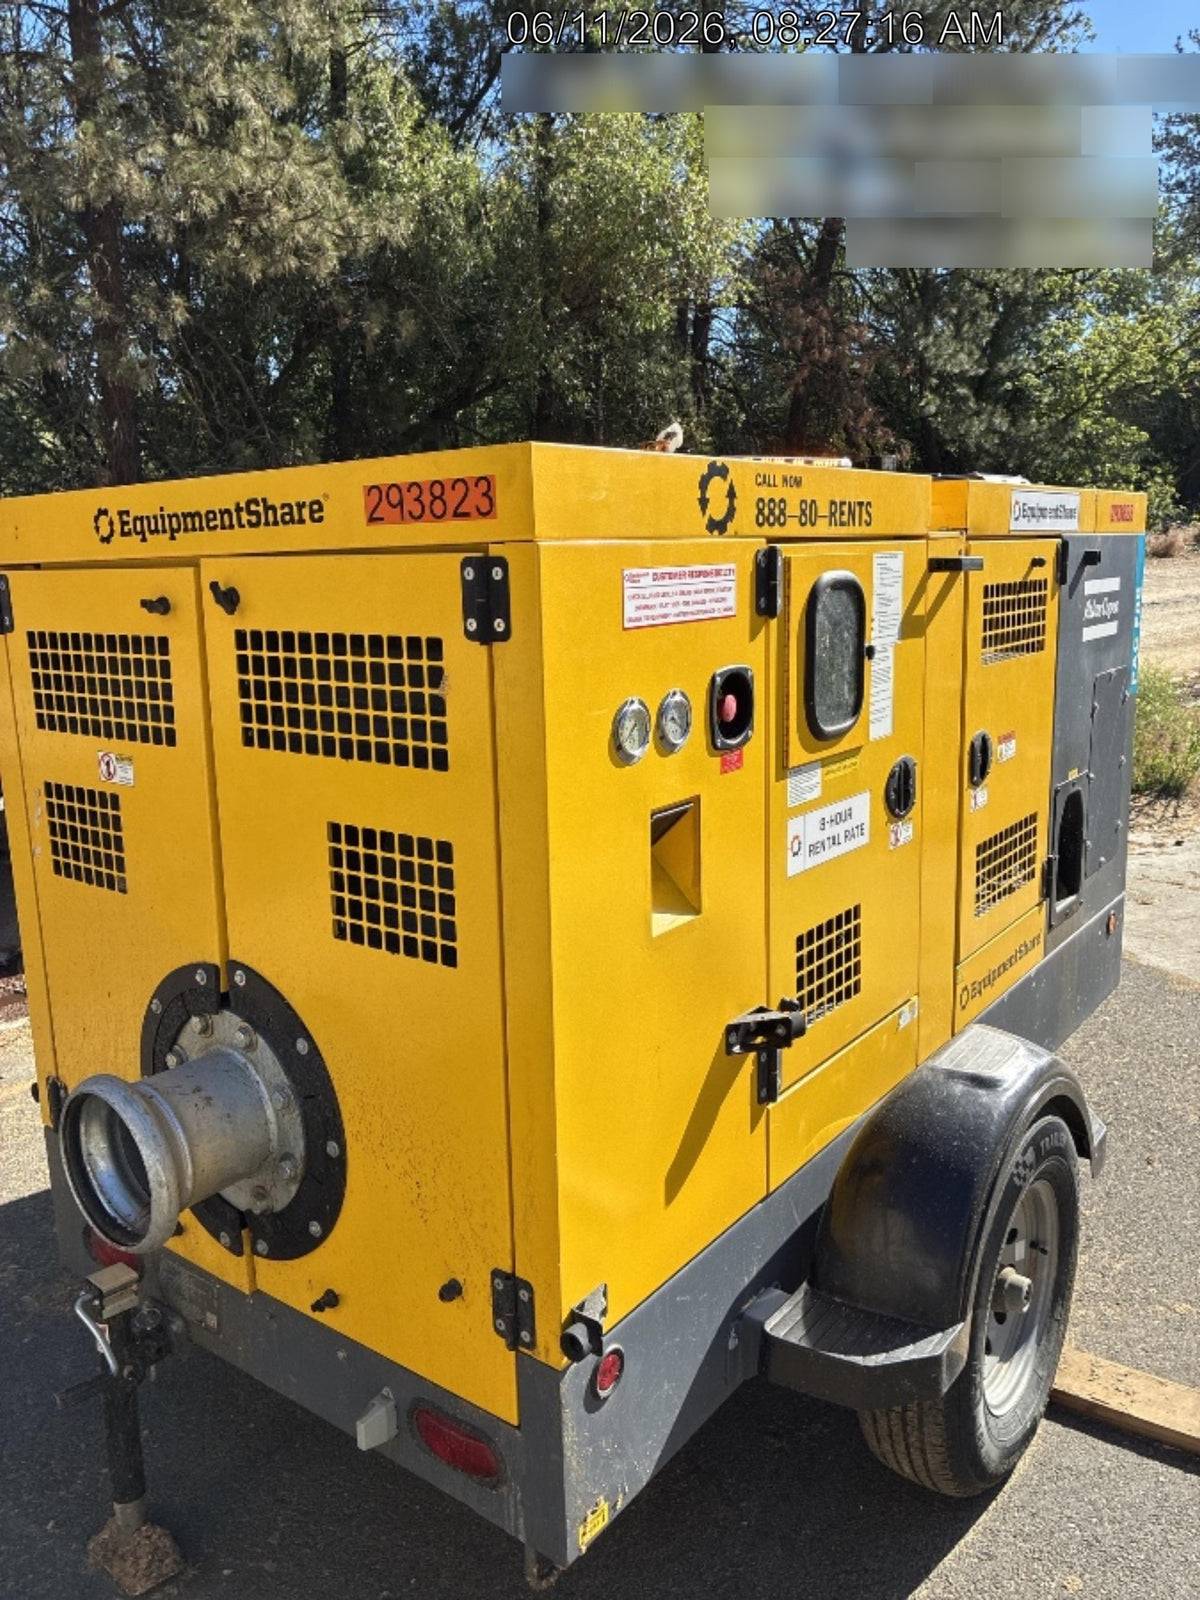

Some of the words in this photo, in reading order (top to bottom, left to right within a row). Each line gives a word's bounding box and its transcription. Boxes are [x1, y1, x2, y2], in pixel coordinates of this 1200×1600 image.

[755, 473, 778, 488] CALL
[782, 475, 803, 488] NOW
[367, 476, 494, 523] 293823
[755, 497, 872, 527] 888-80-RENTS
[117, 497, 324, 543] EquipmentShare
[820, 806, 853, 831] 8-HOUR
[808, 833, 842, 858] RENTAL
[844, 822, 865, 843] RATE
